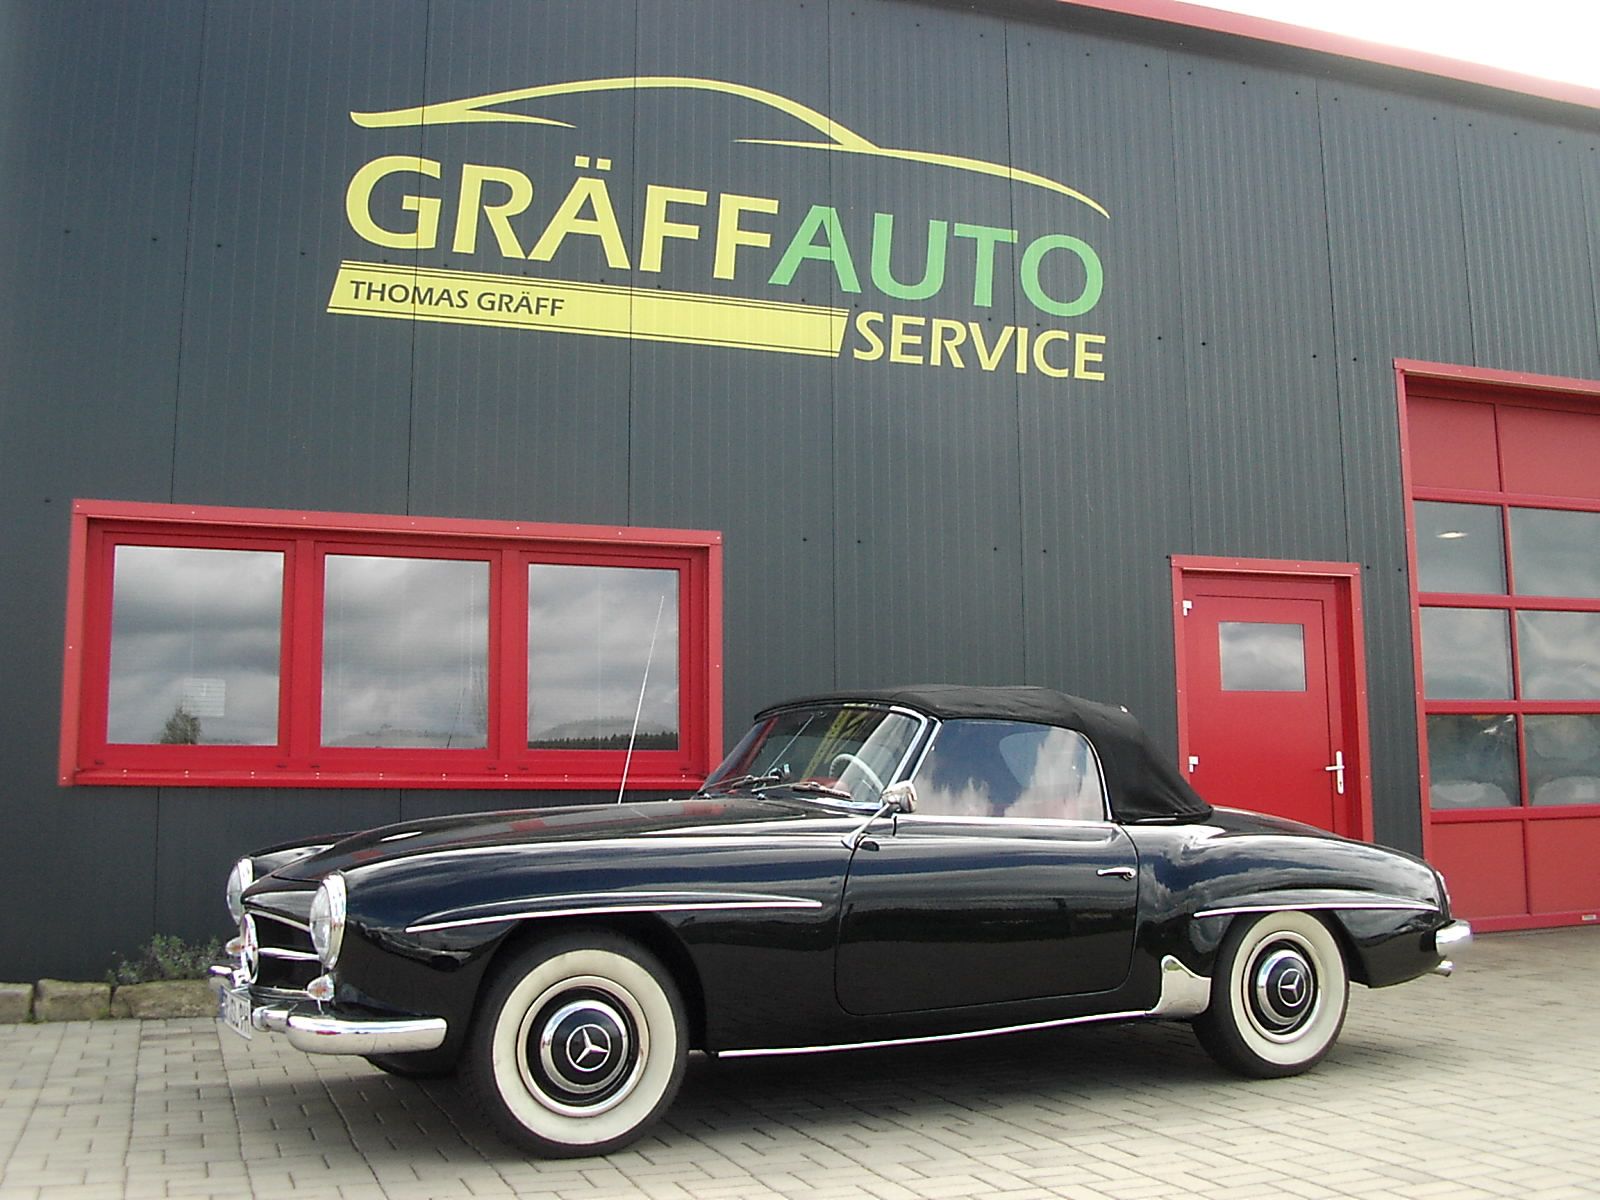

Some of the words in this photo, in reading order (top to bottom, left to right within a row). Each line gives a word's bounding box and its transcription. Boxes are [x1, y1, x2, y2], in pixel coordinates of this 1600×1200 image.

[350, 280, 469, 309] THOMAS
[477, 290, 565, 317] GRÄFF
[853, 311, 1106, 381] SERVICE
